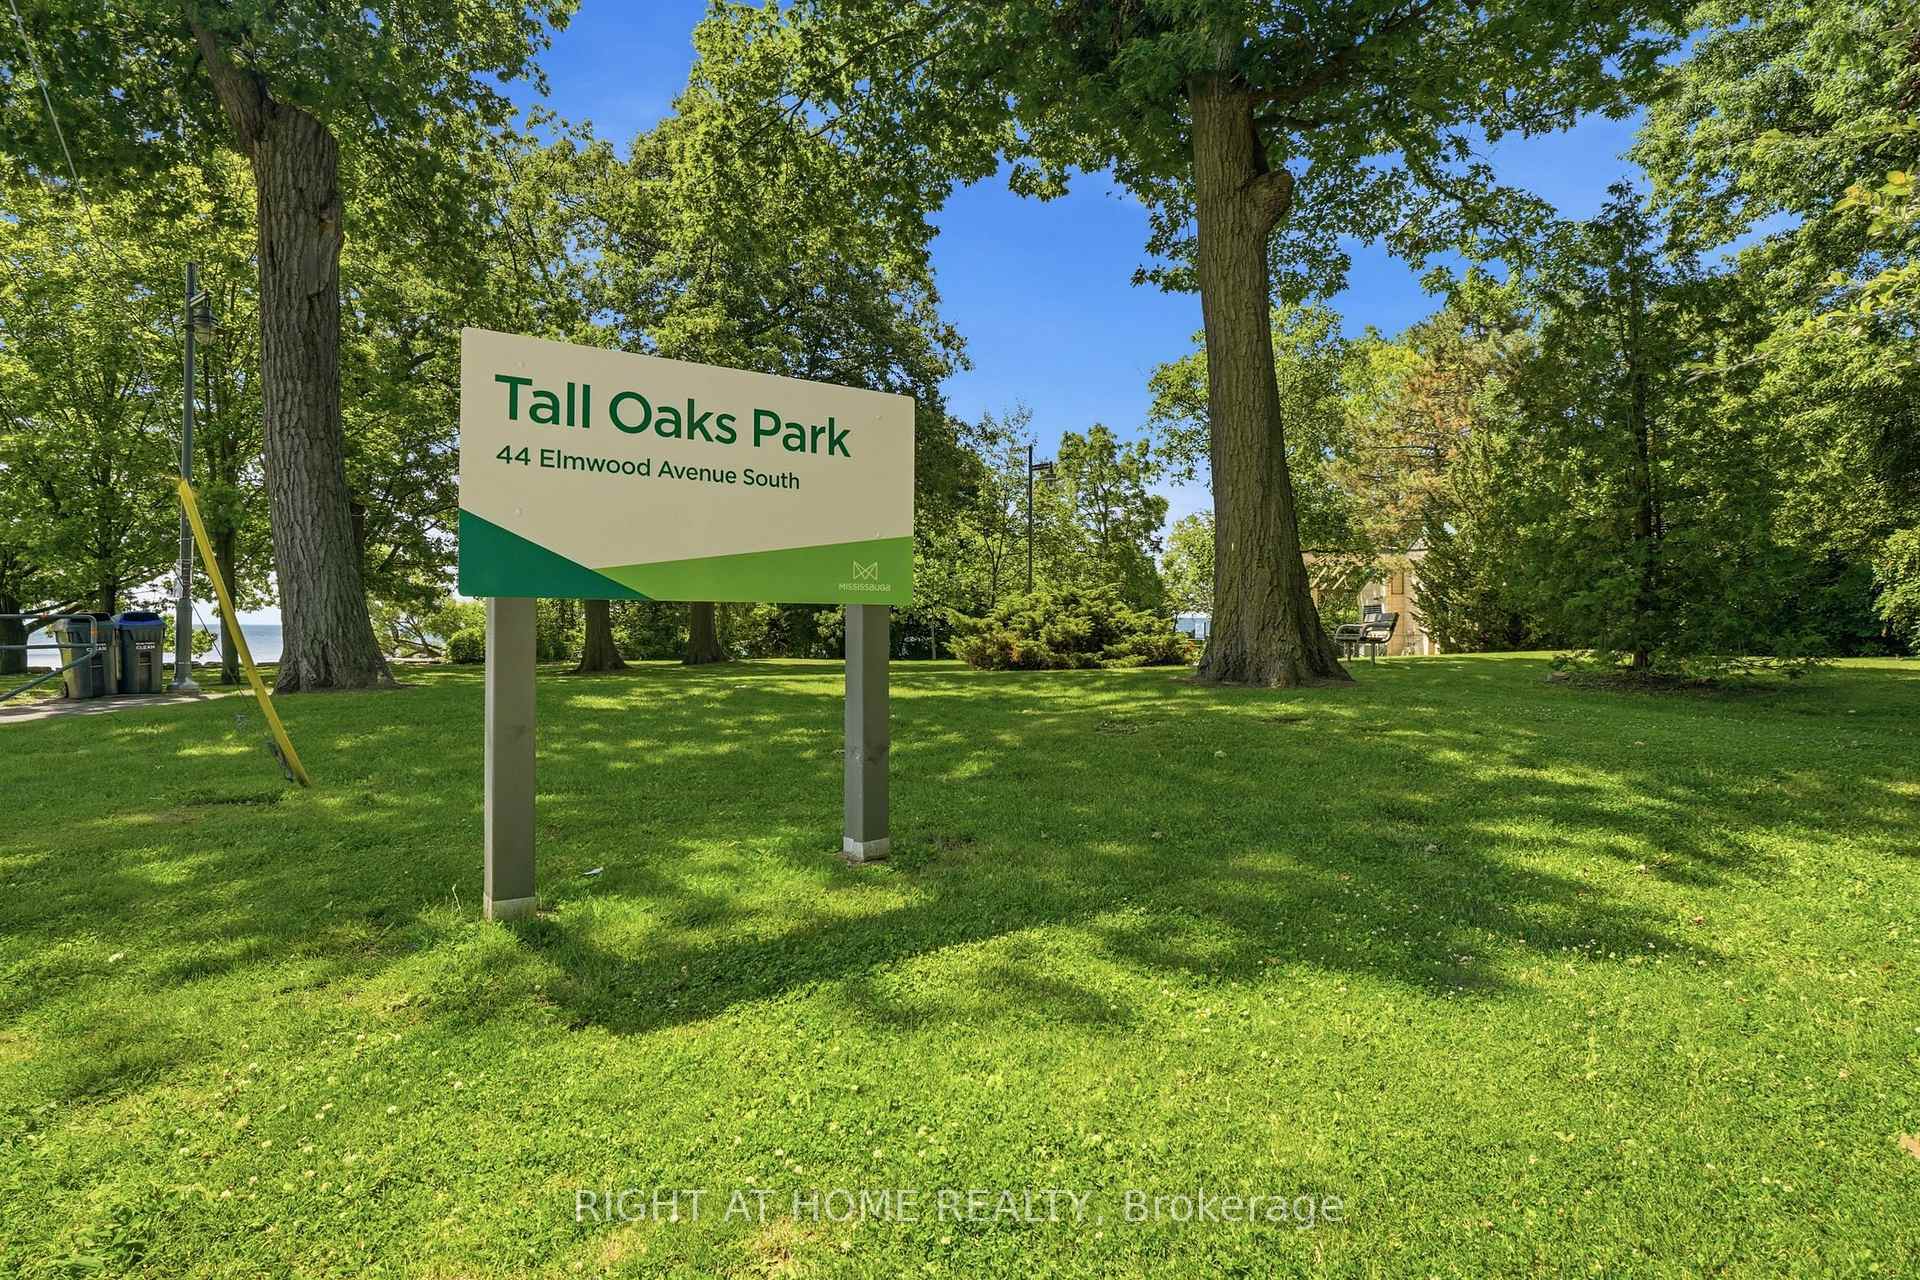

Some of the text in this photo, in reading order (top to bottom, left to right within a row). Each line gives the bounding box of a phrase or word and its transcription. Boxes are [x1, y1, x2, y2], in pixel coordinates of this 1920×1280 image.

[494, 373, 852, 458] Tall Oaks Park
[495, 445, 800, 490] 44 Elmwood Avenue South
